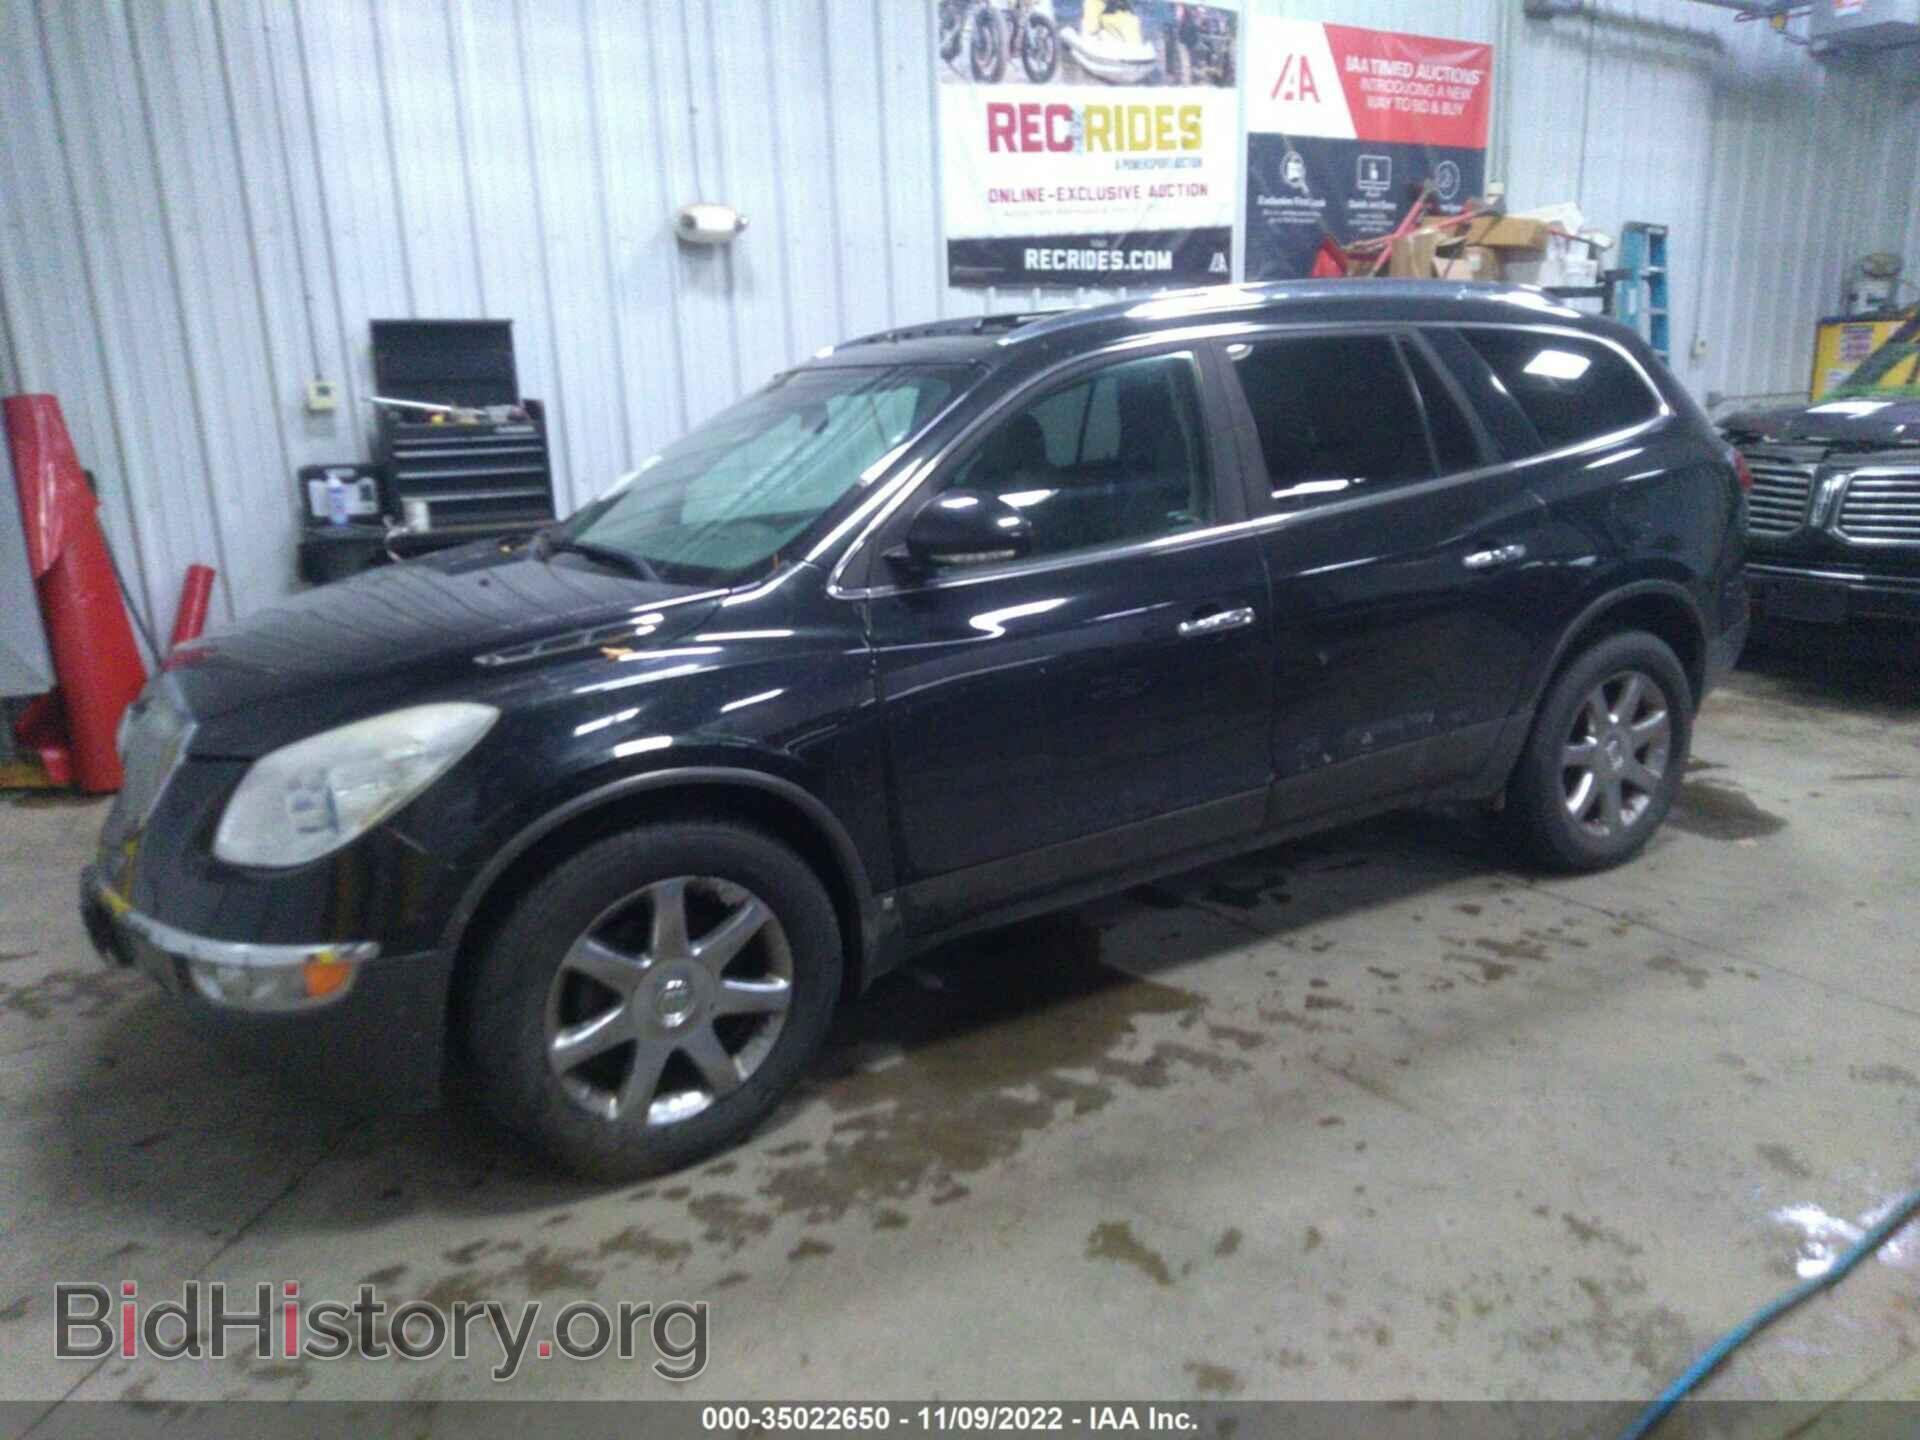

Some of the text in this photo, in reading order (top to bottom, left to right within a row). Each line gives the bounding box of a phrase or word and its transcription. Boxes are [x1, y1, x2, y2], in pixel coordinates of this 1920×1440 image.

[1083, 104, 1202, 152] RIDES
[988, 183, 1208, 203] ONLINE-EXCLUSIVE AUCTION
[1025, 248, 1172, 271] RECRIDES.COM
